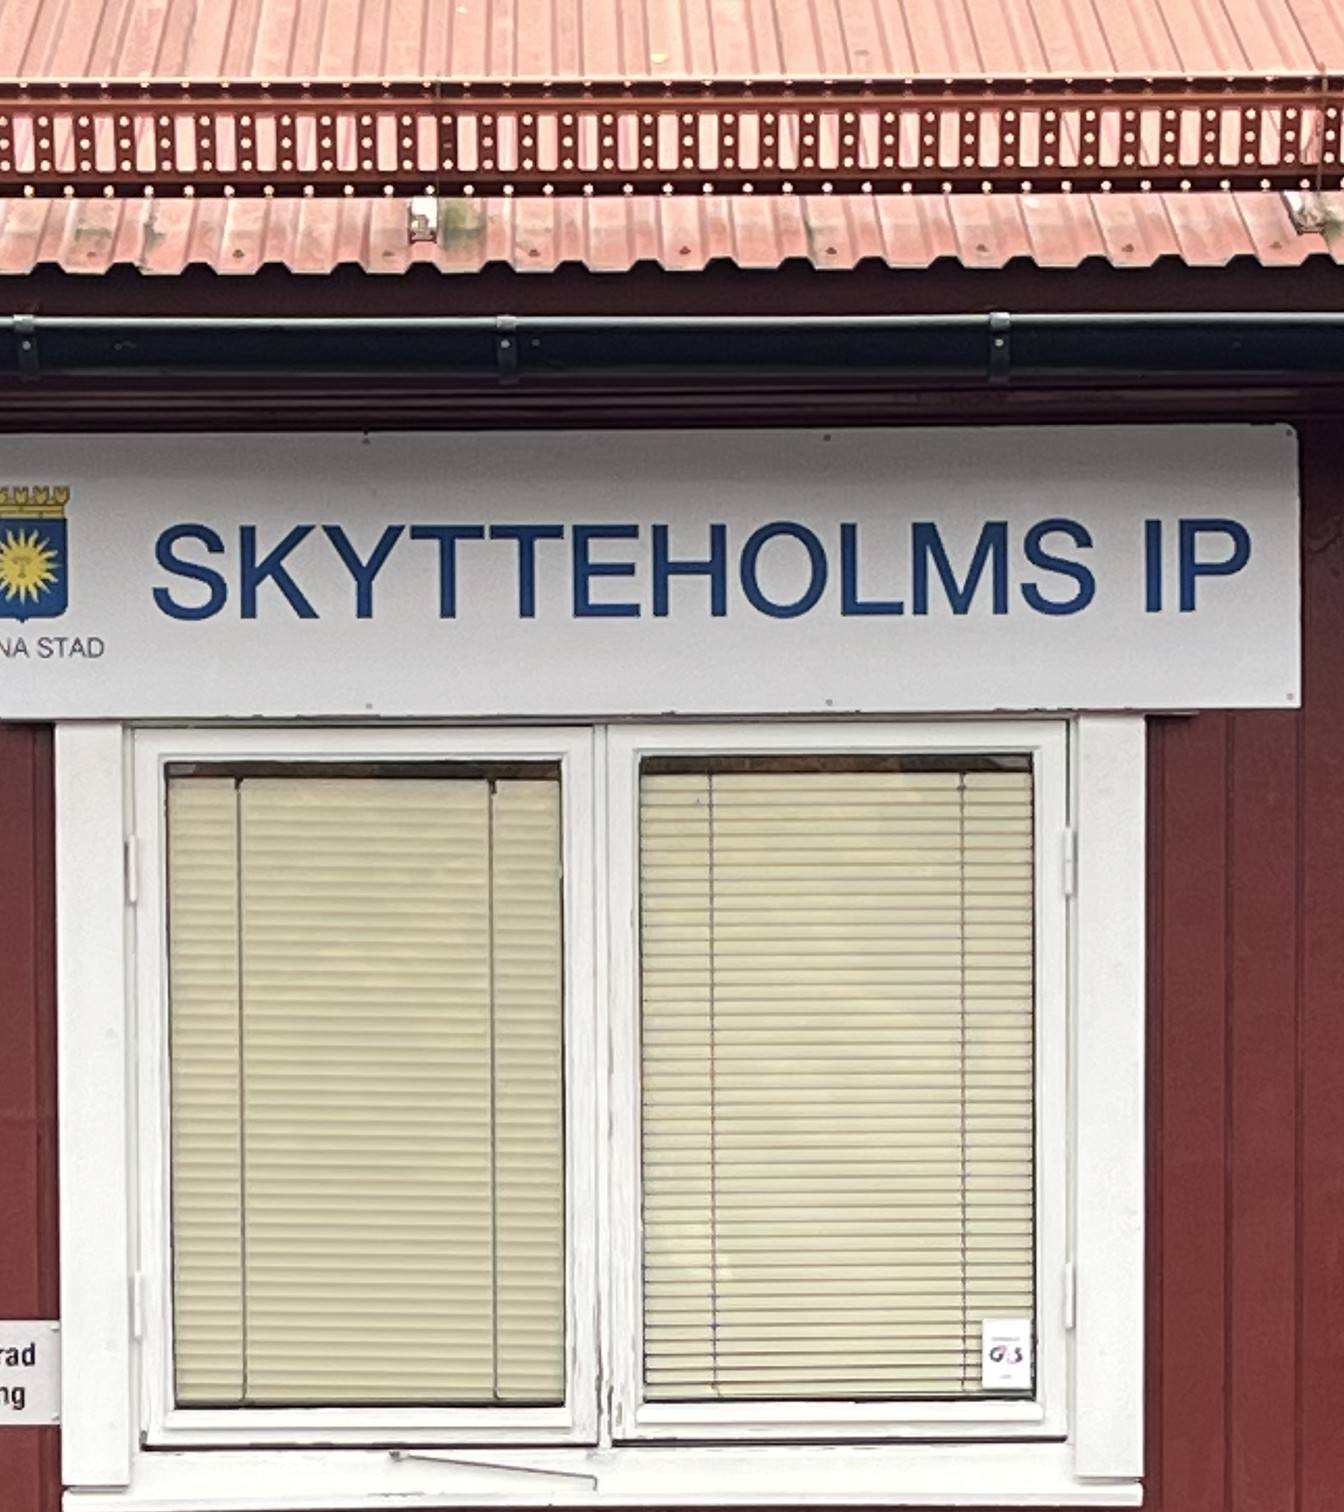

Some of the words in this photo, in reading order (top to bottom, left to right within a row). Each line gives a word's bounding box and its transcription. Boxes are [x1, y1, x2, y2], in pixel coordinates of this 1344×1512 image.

[151, 518, 1097, 621] SKYTTEHOLMS
[1144, 517, 1252, 613] IP
[37, 637, 104, 658] STAD
